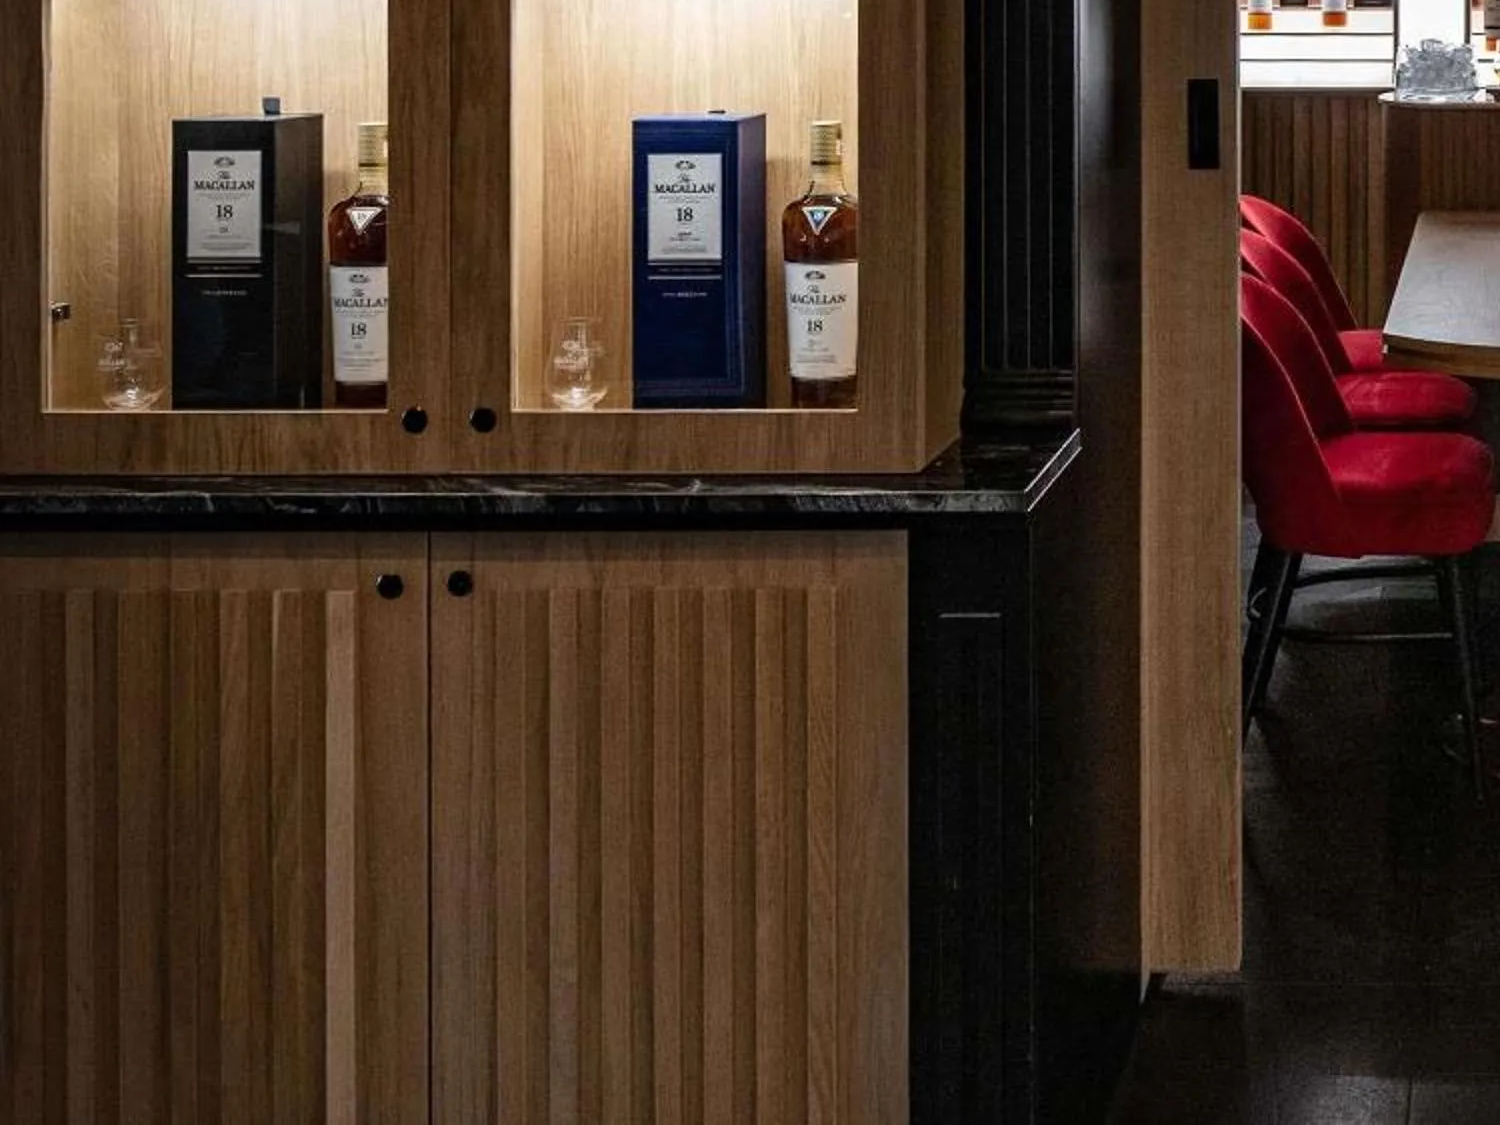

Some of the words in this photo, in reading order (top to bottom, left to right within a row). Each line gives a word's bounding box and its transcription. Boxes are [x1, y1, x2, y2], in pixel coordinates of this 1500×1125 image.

[193, 180, 256, 191] MACALLAN
[654, 183, 717, 195] MACALLAN
[216, 204, 233, 219] 18
[676, 207, 694, 222] 18
[789, 292, 847, 305] MACALLAN
[351, 322, 367, 336] 18
[807, 318, 824, 333] 18
